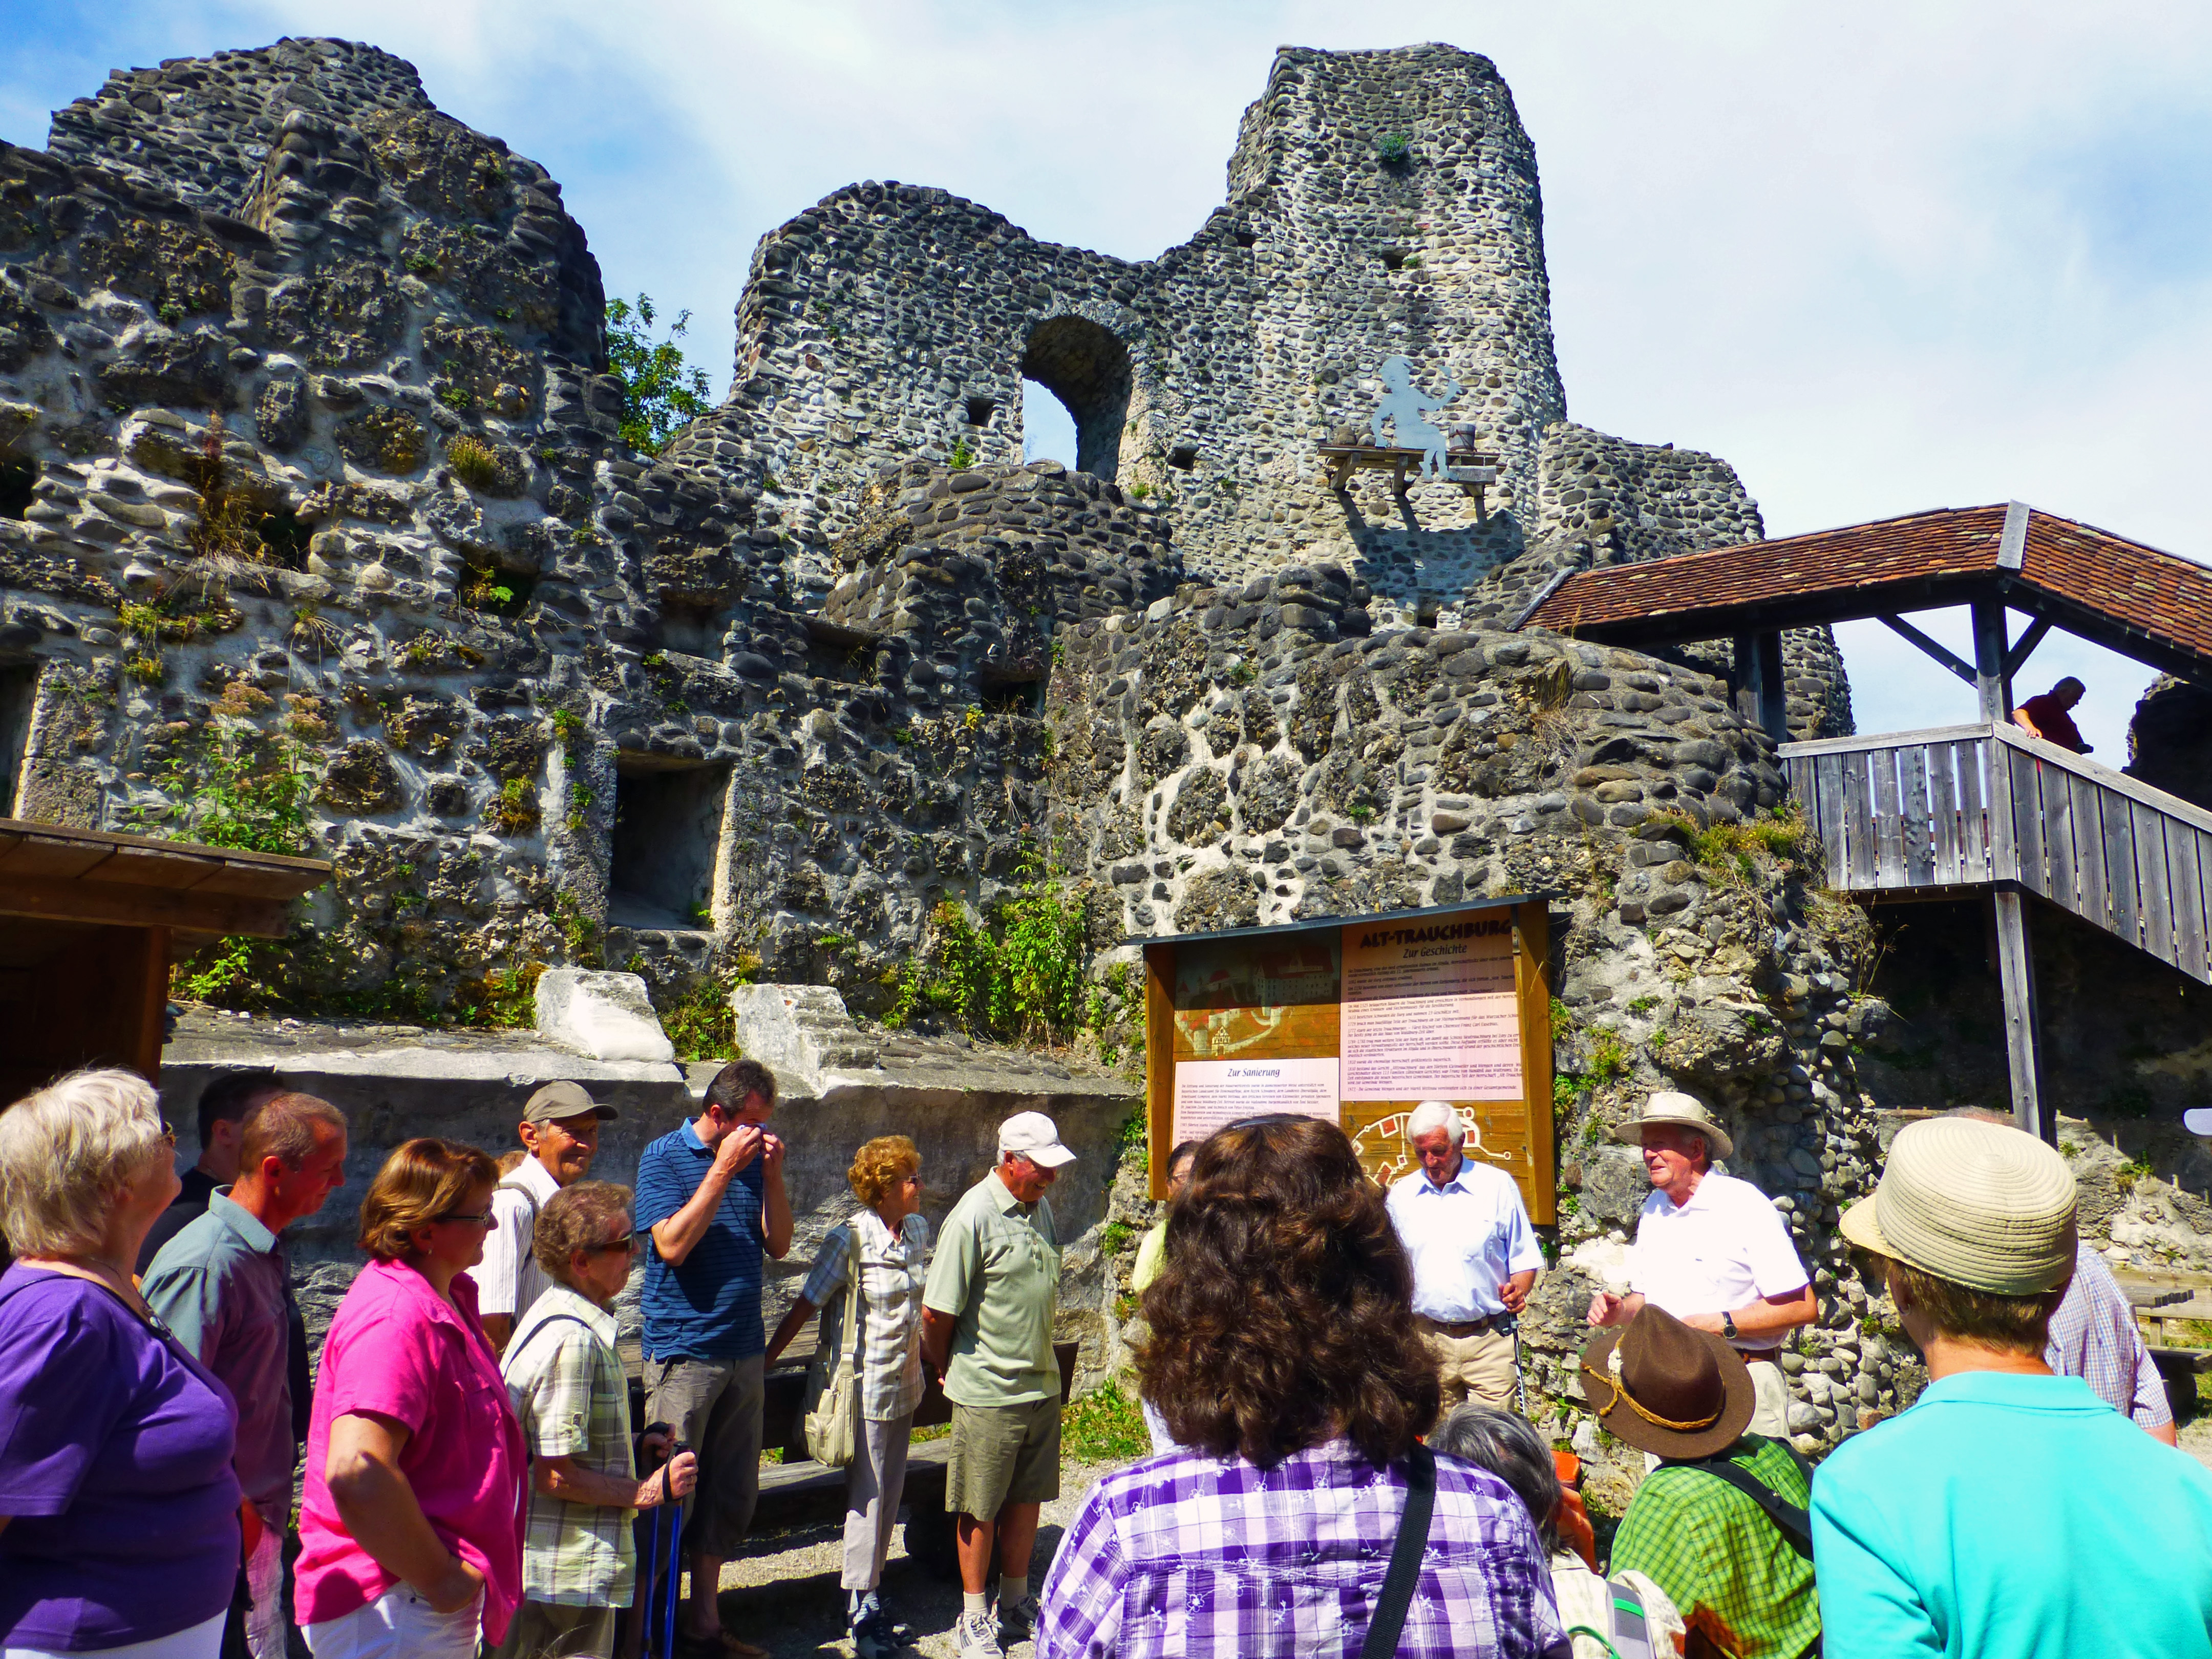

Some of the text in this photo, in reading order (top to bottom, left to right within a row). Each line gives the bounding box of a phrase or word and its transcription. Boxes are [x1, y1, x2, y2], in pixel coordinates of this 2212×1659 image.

[1360, 919, 1512, 948] ALT-TRAUCHBURG
[1403, 944, 1467, 959] Zur Geschichte
[1227, 1068, 1280, 1078] Zur Sanierung
